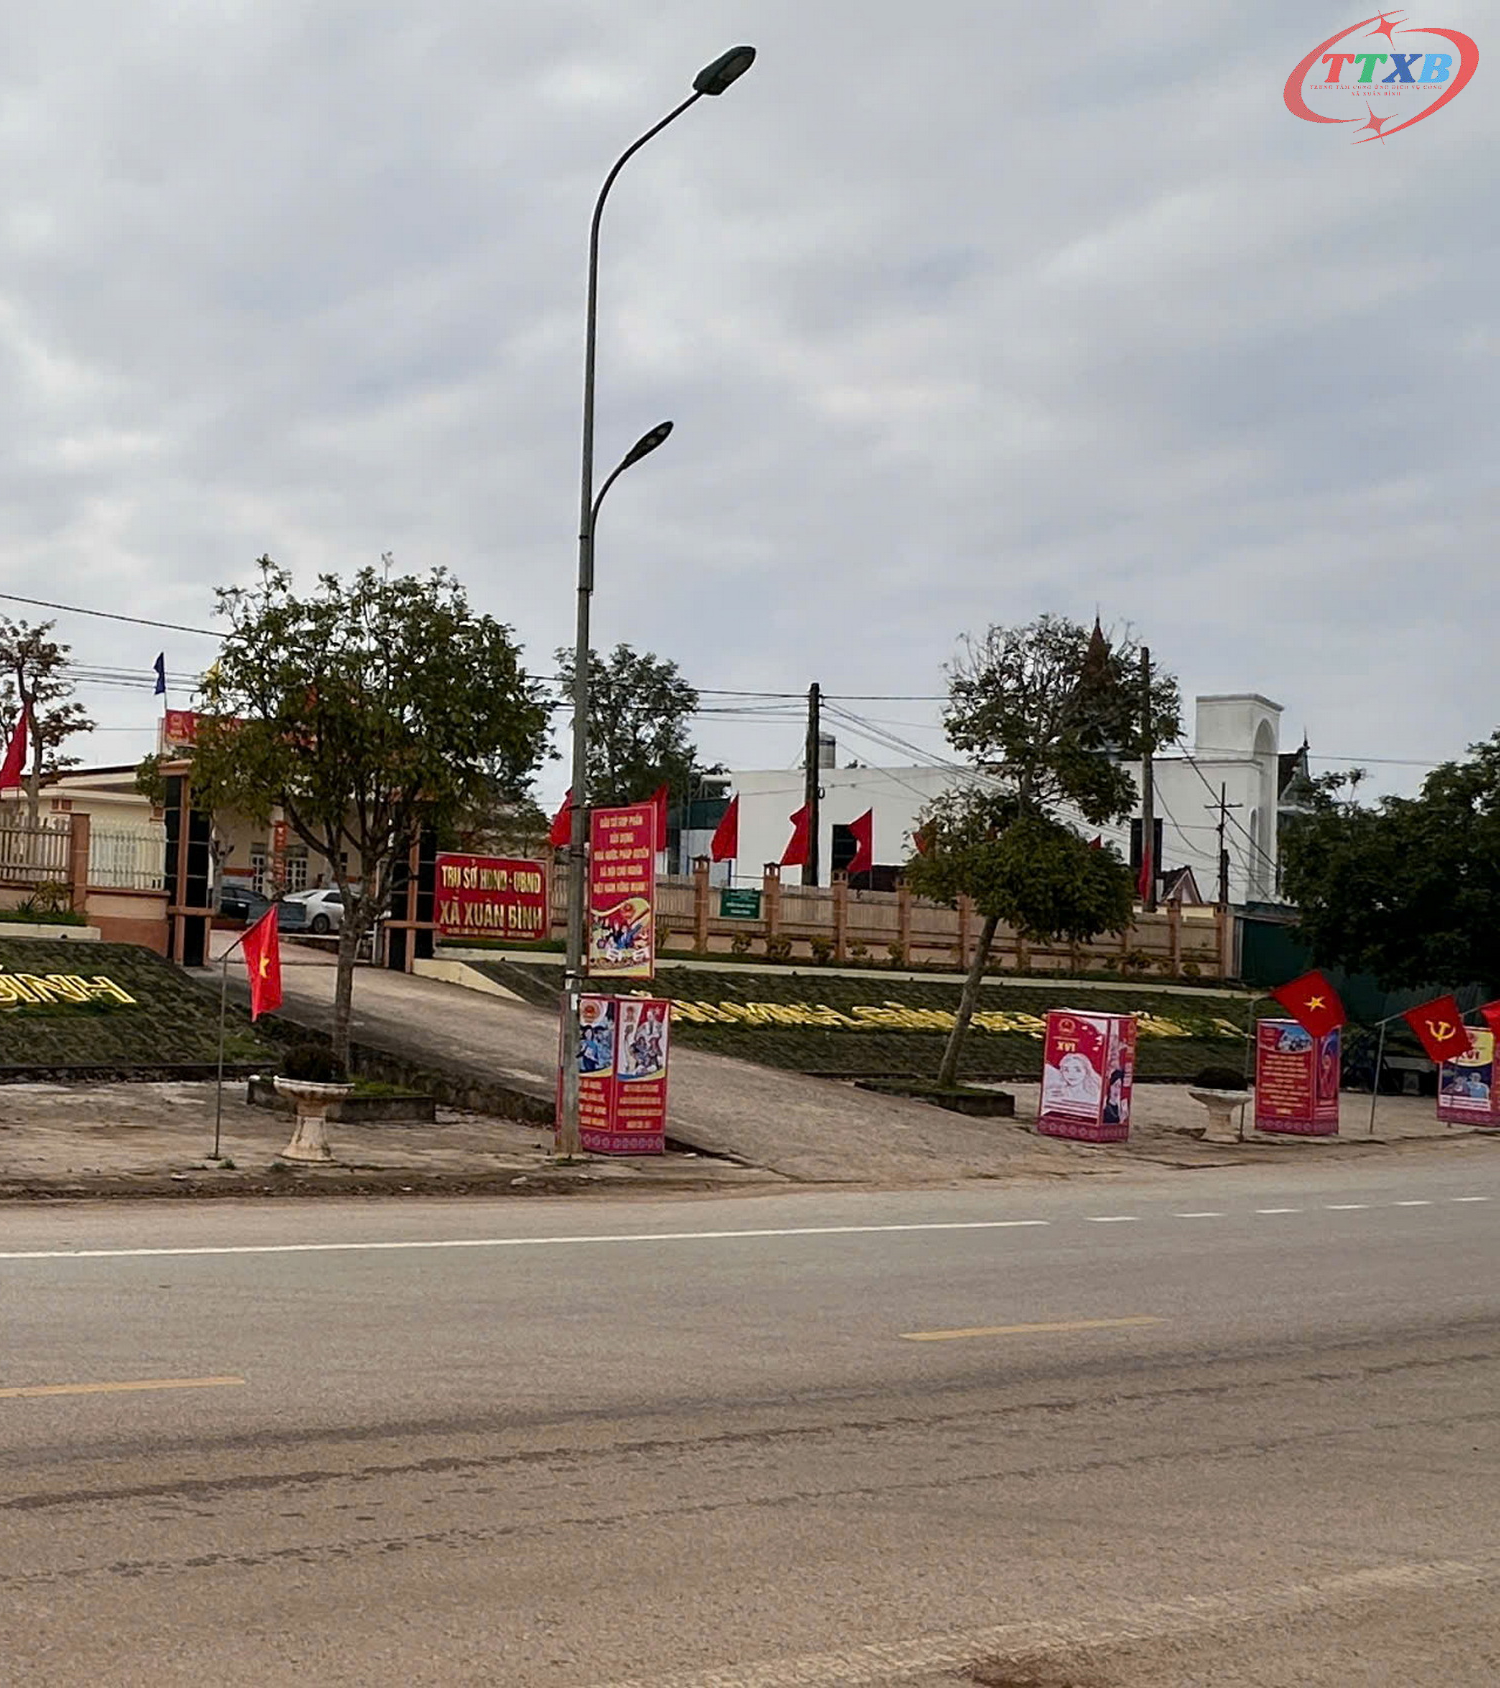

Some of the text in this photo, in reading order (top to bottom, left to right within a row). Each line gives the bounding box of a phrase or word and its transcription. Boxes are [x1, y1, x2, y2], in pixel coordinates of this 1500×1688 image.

[441, 865, 461, 893] TRỤ
[463, 859, 478, 889] SỞ
[440, 896, 542, 930] XÃ XUÂN BÌNH
